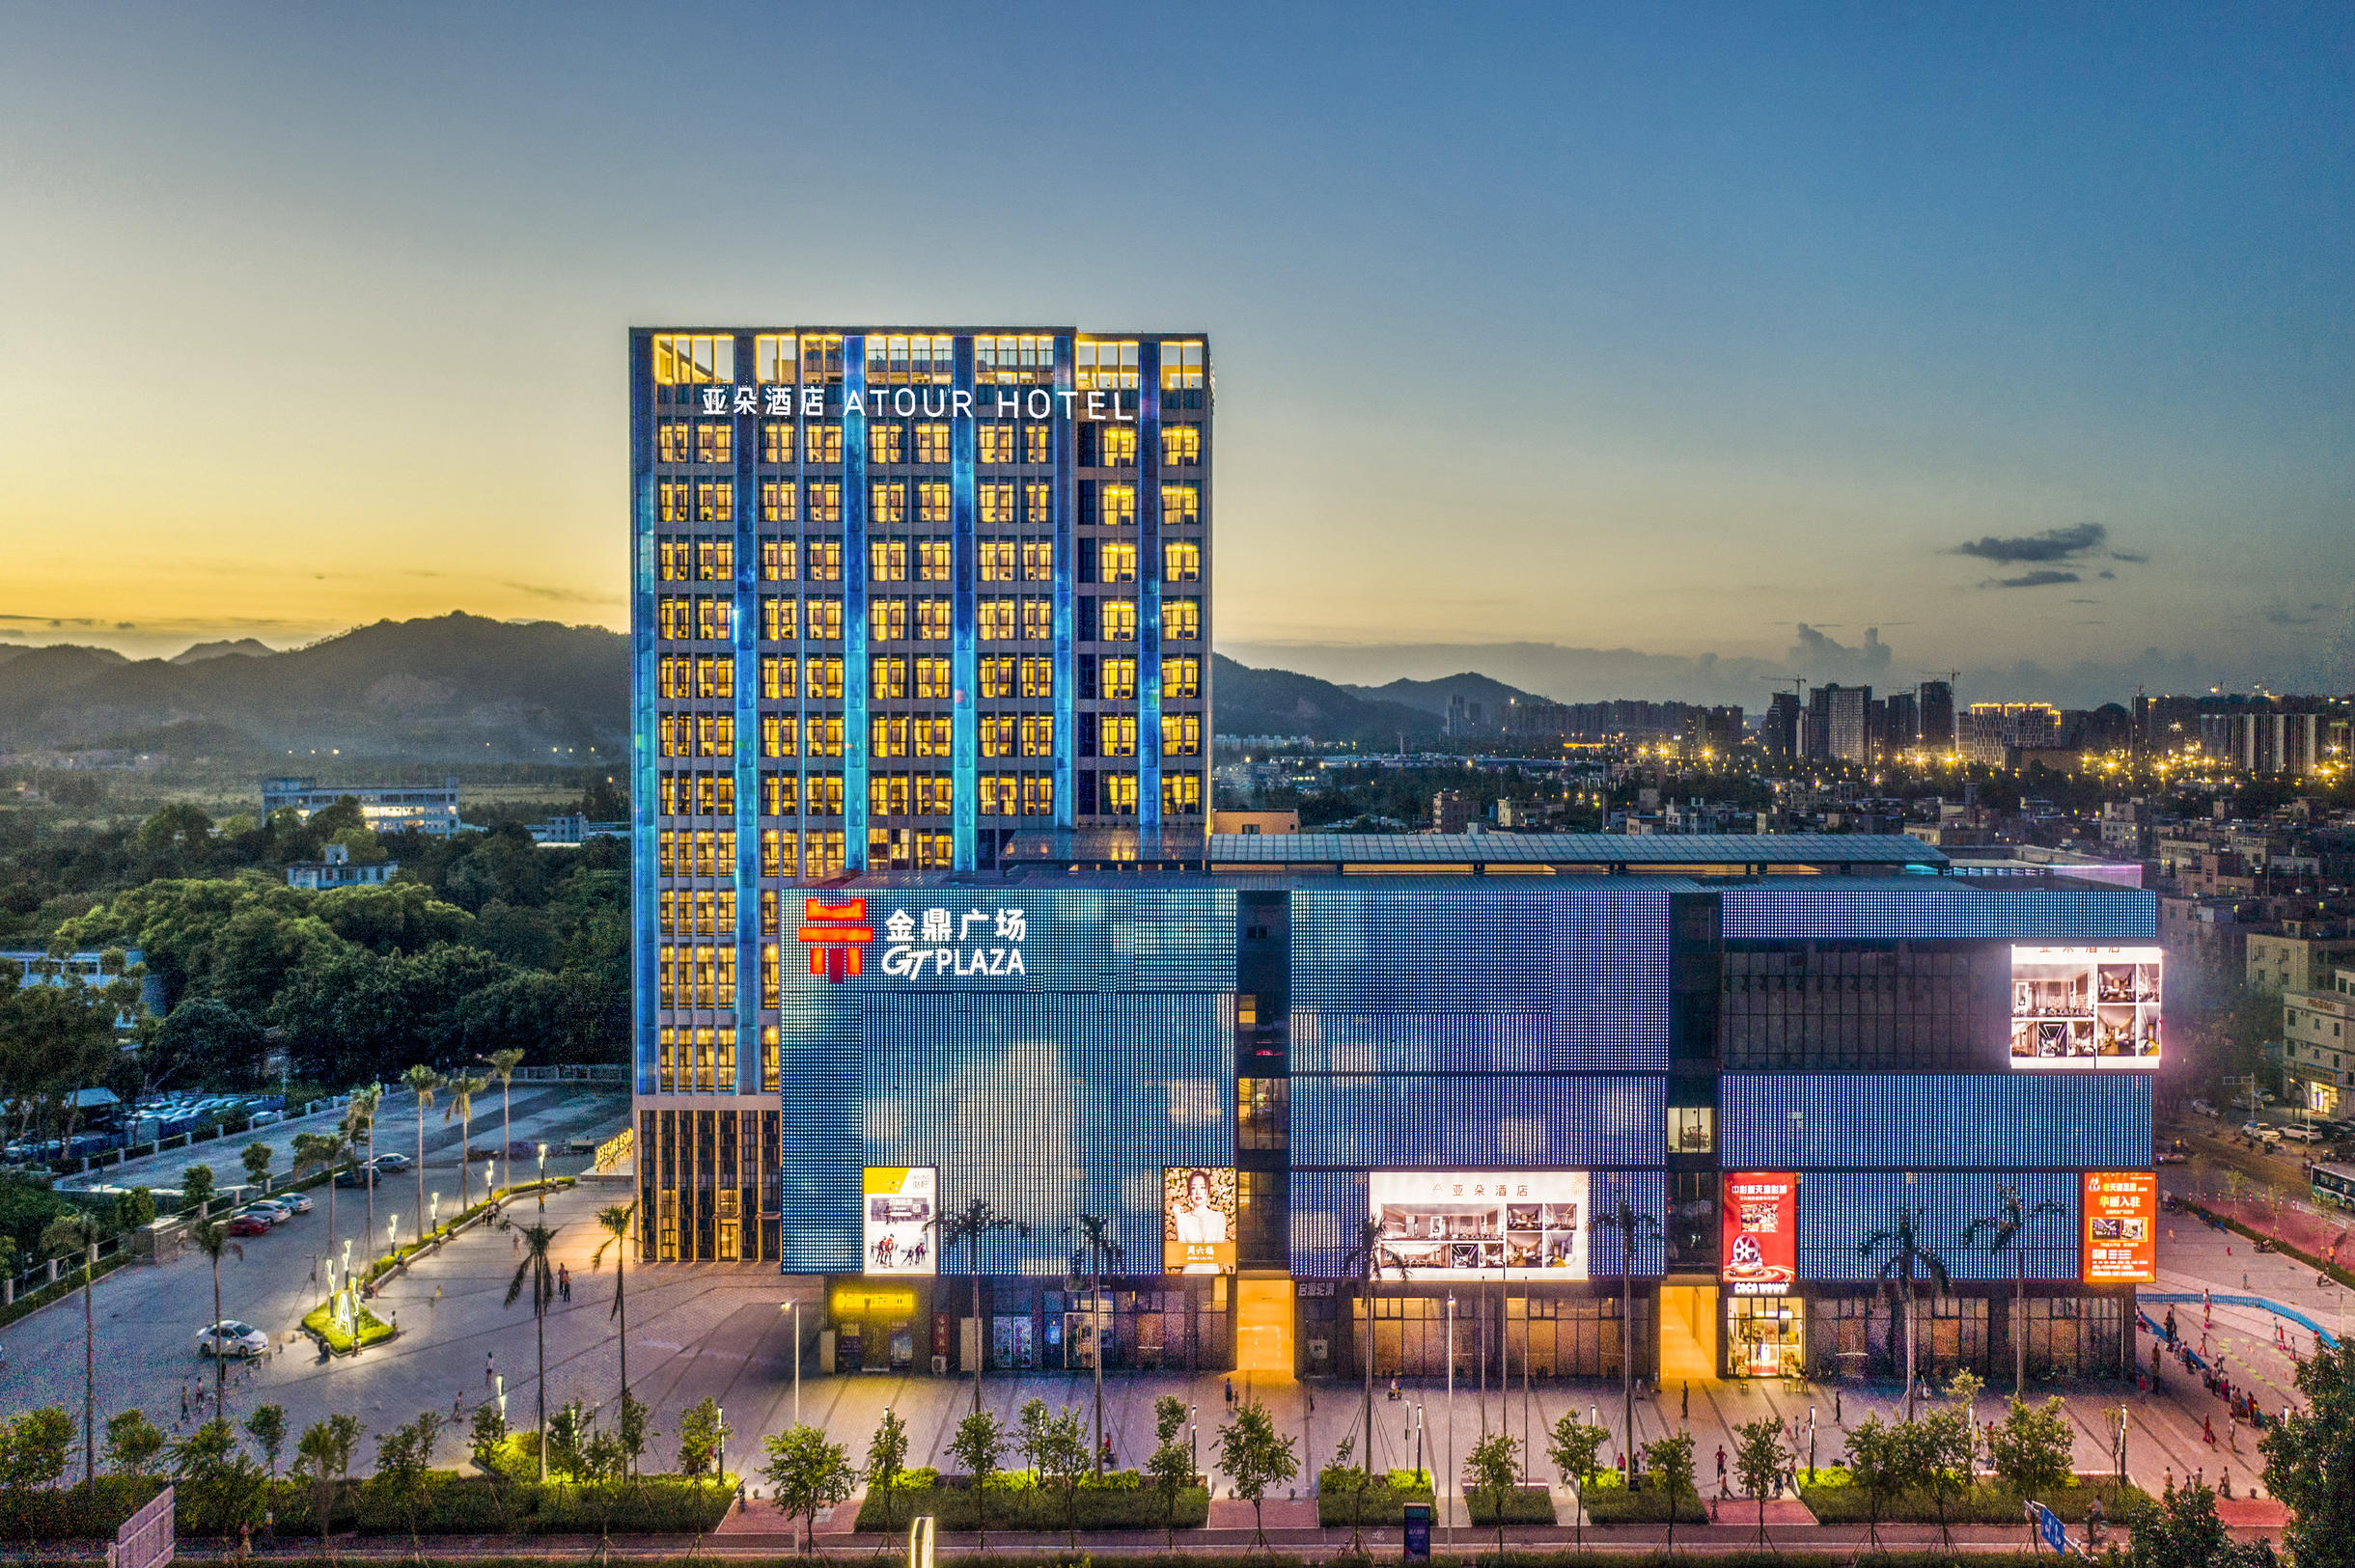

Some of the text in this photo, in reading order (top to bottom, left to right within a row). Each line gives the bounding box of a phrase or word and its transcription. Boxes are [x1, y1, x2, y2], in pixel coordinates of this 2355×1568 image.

[702, 386, 1134, 421] 亚朵酒店 ATOUR HOTEL
[884, 907, 1027, 942] 金鼎广场
[936, 948, 1027, 976] PLAZA
[1453, 1184, 1528, 1197] 亚朵酒店
